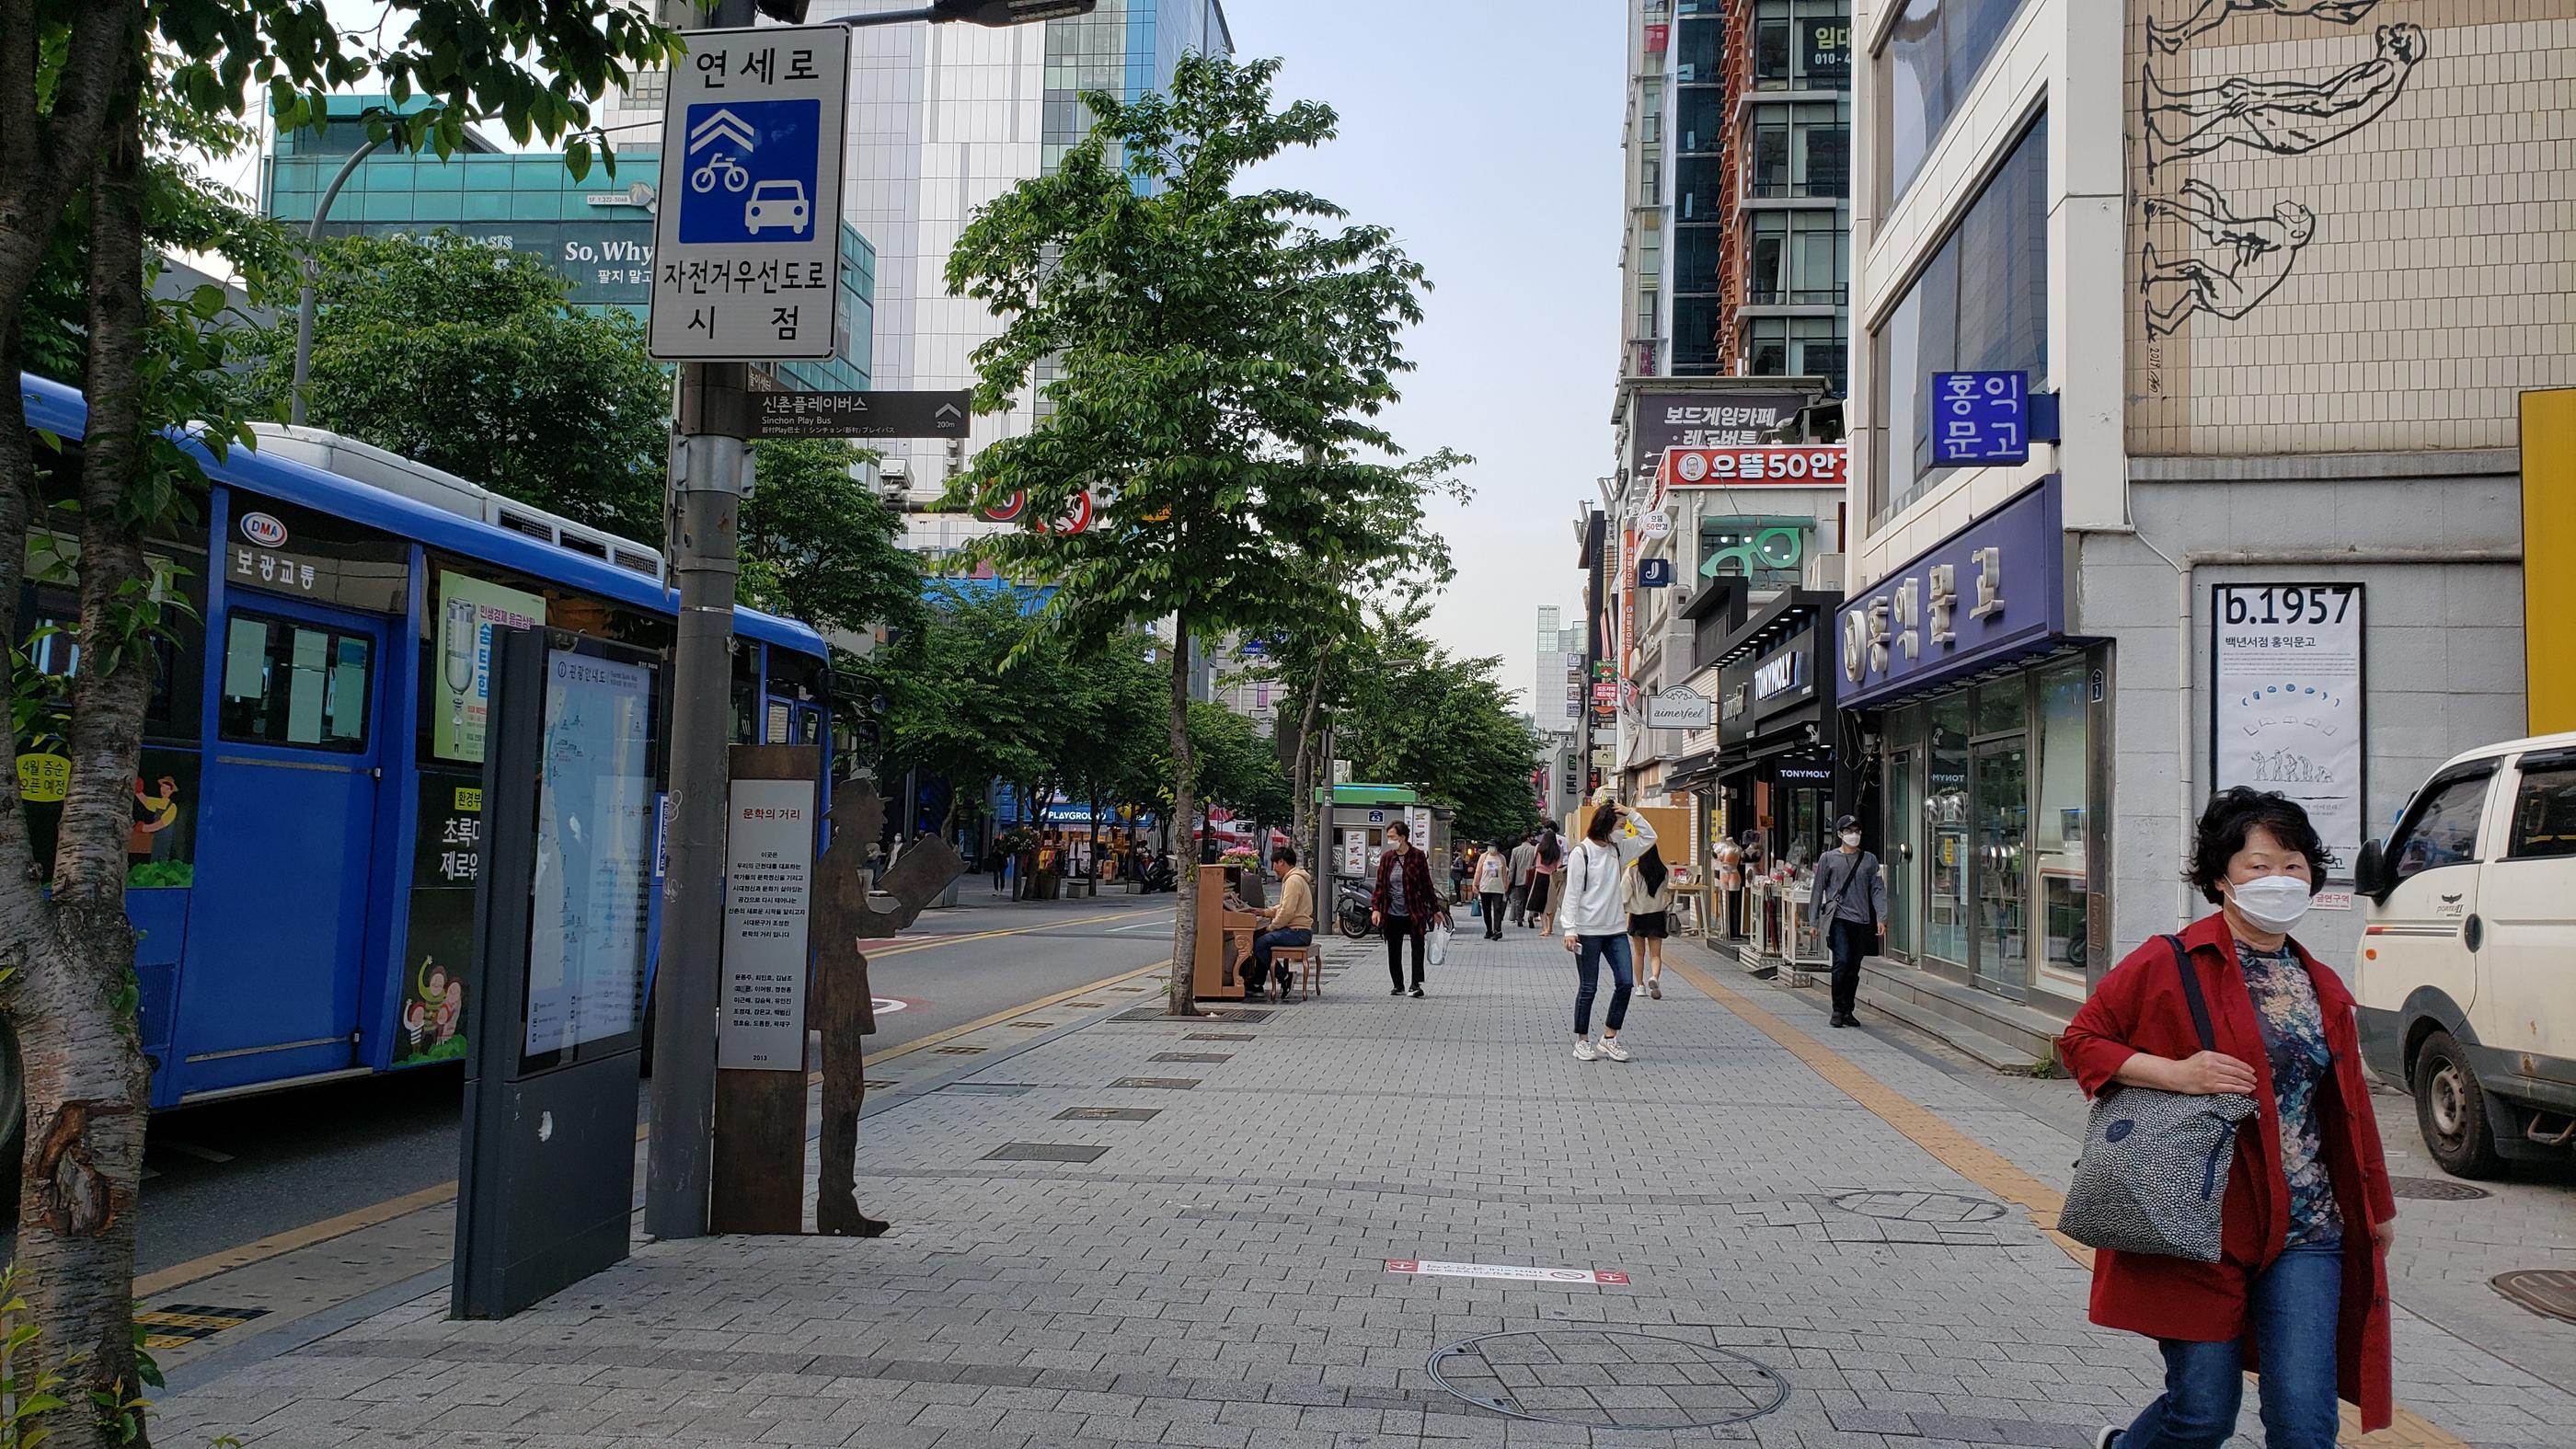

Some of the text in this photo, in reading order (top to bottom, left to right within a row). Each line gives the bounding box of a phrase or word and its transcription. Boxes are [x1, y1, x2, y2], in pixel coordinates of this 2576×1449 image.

[598, 269, 624, 284] 팔지
[663, 259, 827, 294] 자전거우선도로
[762, 396, 868, 413] 신촌플레이버스
[762, 416, 832, 426] Sinchon Play Bus
[937, 420, 955, 429] 200m
[1664, 407, 1777, 427] 보드게임카페
[1710, 453, 1847, 478] 으뜸50안
[251, 520, 278, 538] DMA
[236, 549, 315, 590] 보광교통
[2225, 587, 2353, 626] b.1957
[2225, 637, 2316, 648] 백년서점 홍익문고
[569, 663, 606, 684] 관광안내도
[1754, 650, 1794, 701] TONYMOLY
[1653, 707, 1706, 720] aimerfeel
[1780, 769, 1831, 779] TONYMOLY
[458, 790, 482, 808] 환경부
[742, 809, 800, 820] 문학의 거리
[2316, 893, 2350, 903] 금연구역
